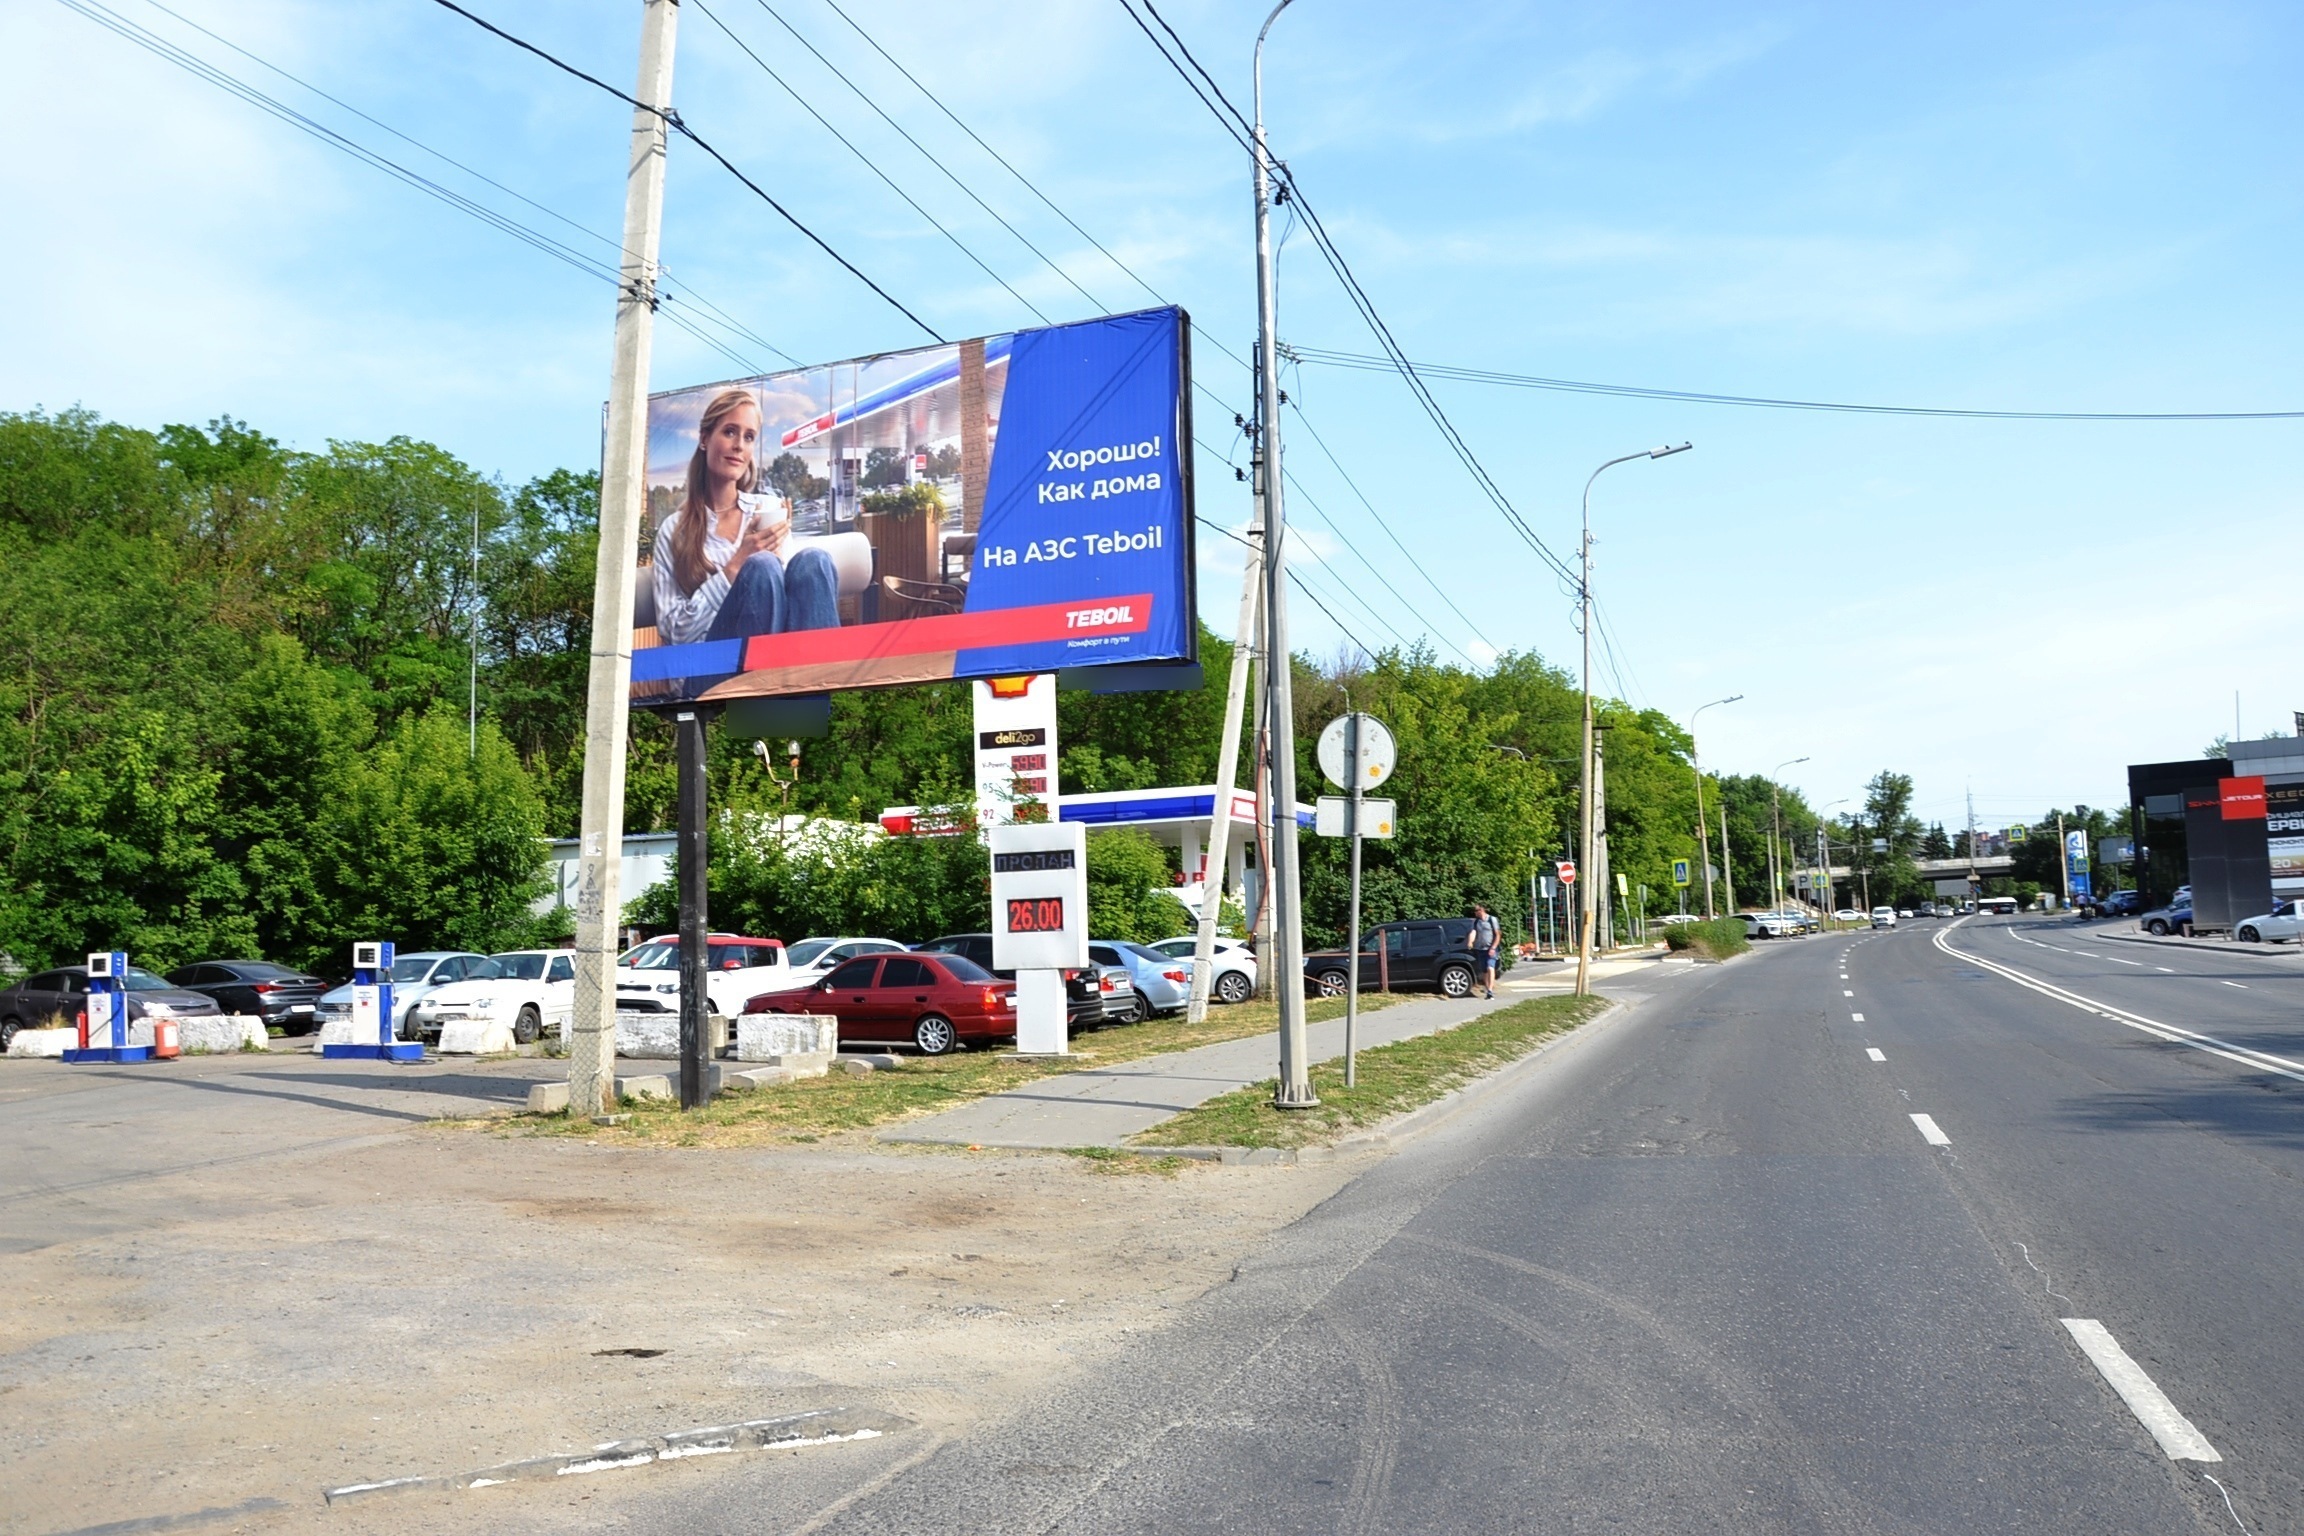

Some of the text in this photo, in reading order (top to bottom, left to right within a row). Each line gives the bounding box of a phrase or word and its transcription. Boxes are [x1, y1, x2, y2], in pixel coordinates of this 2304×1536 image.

[1047, 436, 1161, 472] Хорошо!
[1038, 472, 1161, 504] Как дома
[984, 525, 1162, 568] На АЗС Teboil
[1066, 606, 1134, 629] TEBOIL
[1067, 638, 1102, 648] Комфорт
[1110, 636, 1130, 645] пути
[994, 731, 1036, 746] deli2go
[983, 782, 994, 793] 95
[2222, 794, 2263, 802] JETOUR
[983, 808, 994, 820] 92
[996, 853, 1073, 870] ПРОПАН
[1799, 875, 1808, 887] P
[1009, 900, 1061, 931] 26.00
